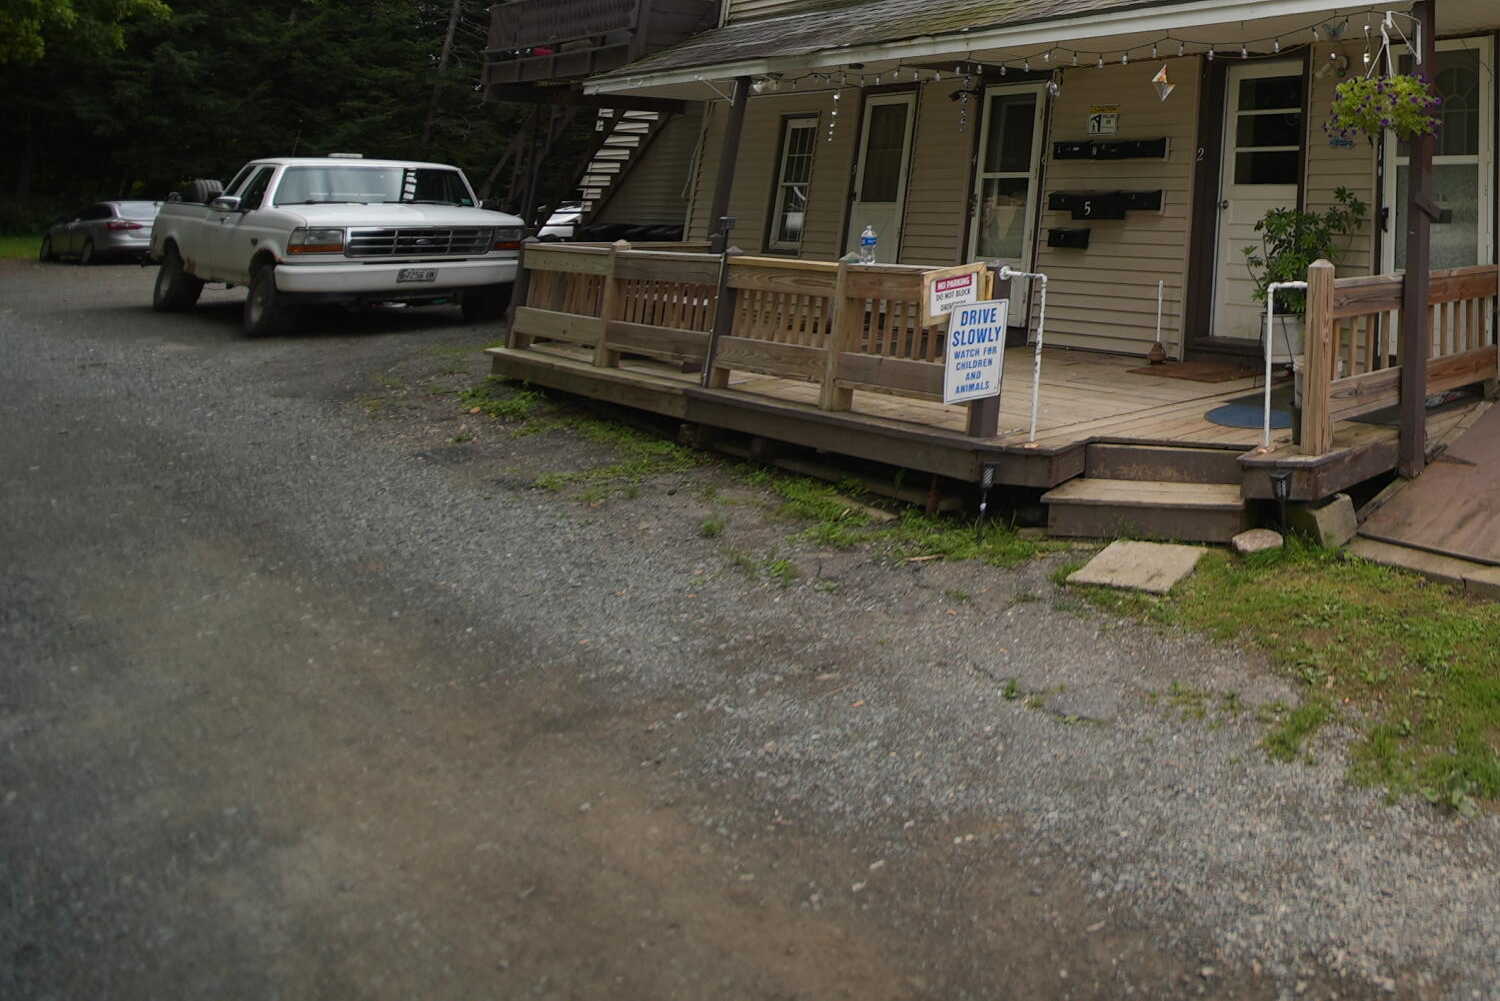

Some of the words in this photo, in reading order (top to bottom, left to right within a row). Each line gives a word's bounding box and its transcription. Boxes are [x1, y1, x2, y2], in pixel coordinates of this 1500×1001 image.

[1196, 147, 1205, 162] 2
[1083, 200, 1092, 216] 5
[937, 281, 947, 291] NO
[946, 276, 971, 288] PARKING
[936, 293, 944, 302] DO
[945, 290, 955, 300] NOT
[956, 288, 971, 298] BLOCK
[960, 307, 997, 326] DRIVE
[952, 326, 1001, 347] SLOWLY
[954, 348, 980, 359] WATCH
[983, 346, 997, 355] FOR
[956, 358, 992, 371] CHILDREN
[965, 371, 981, 381] AND
[955, 381, 990, 394] ANIMALS
